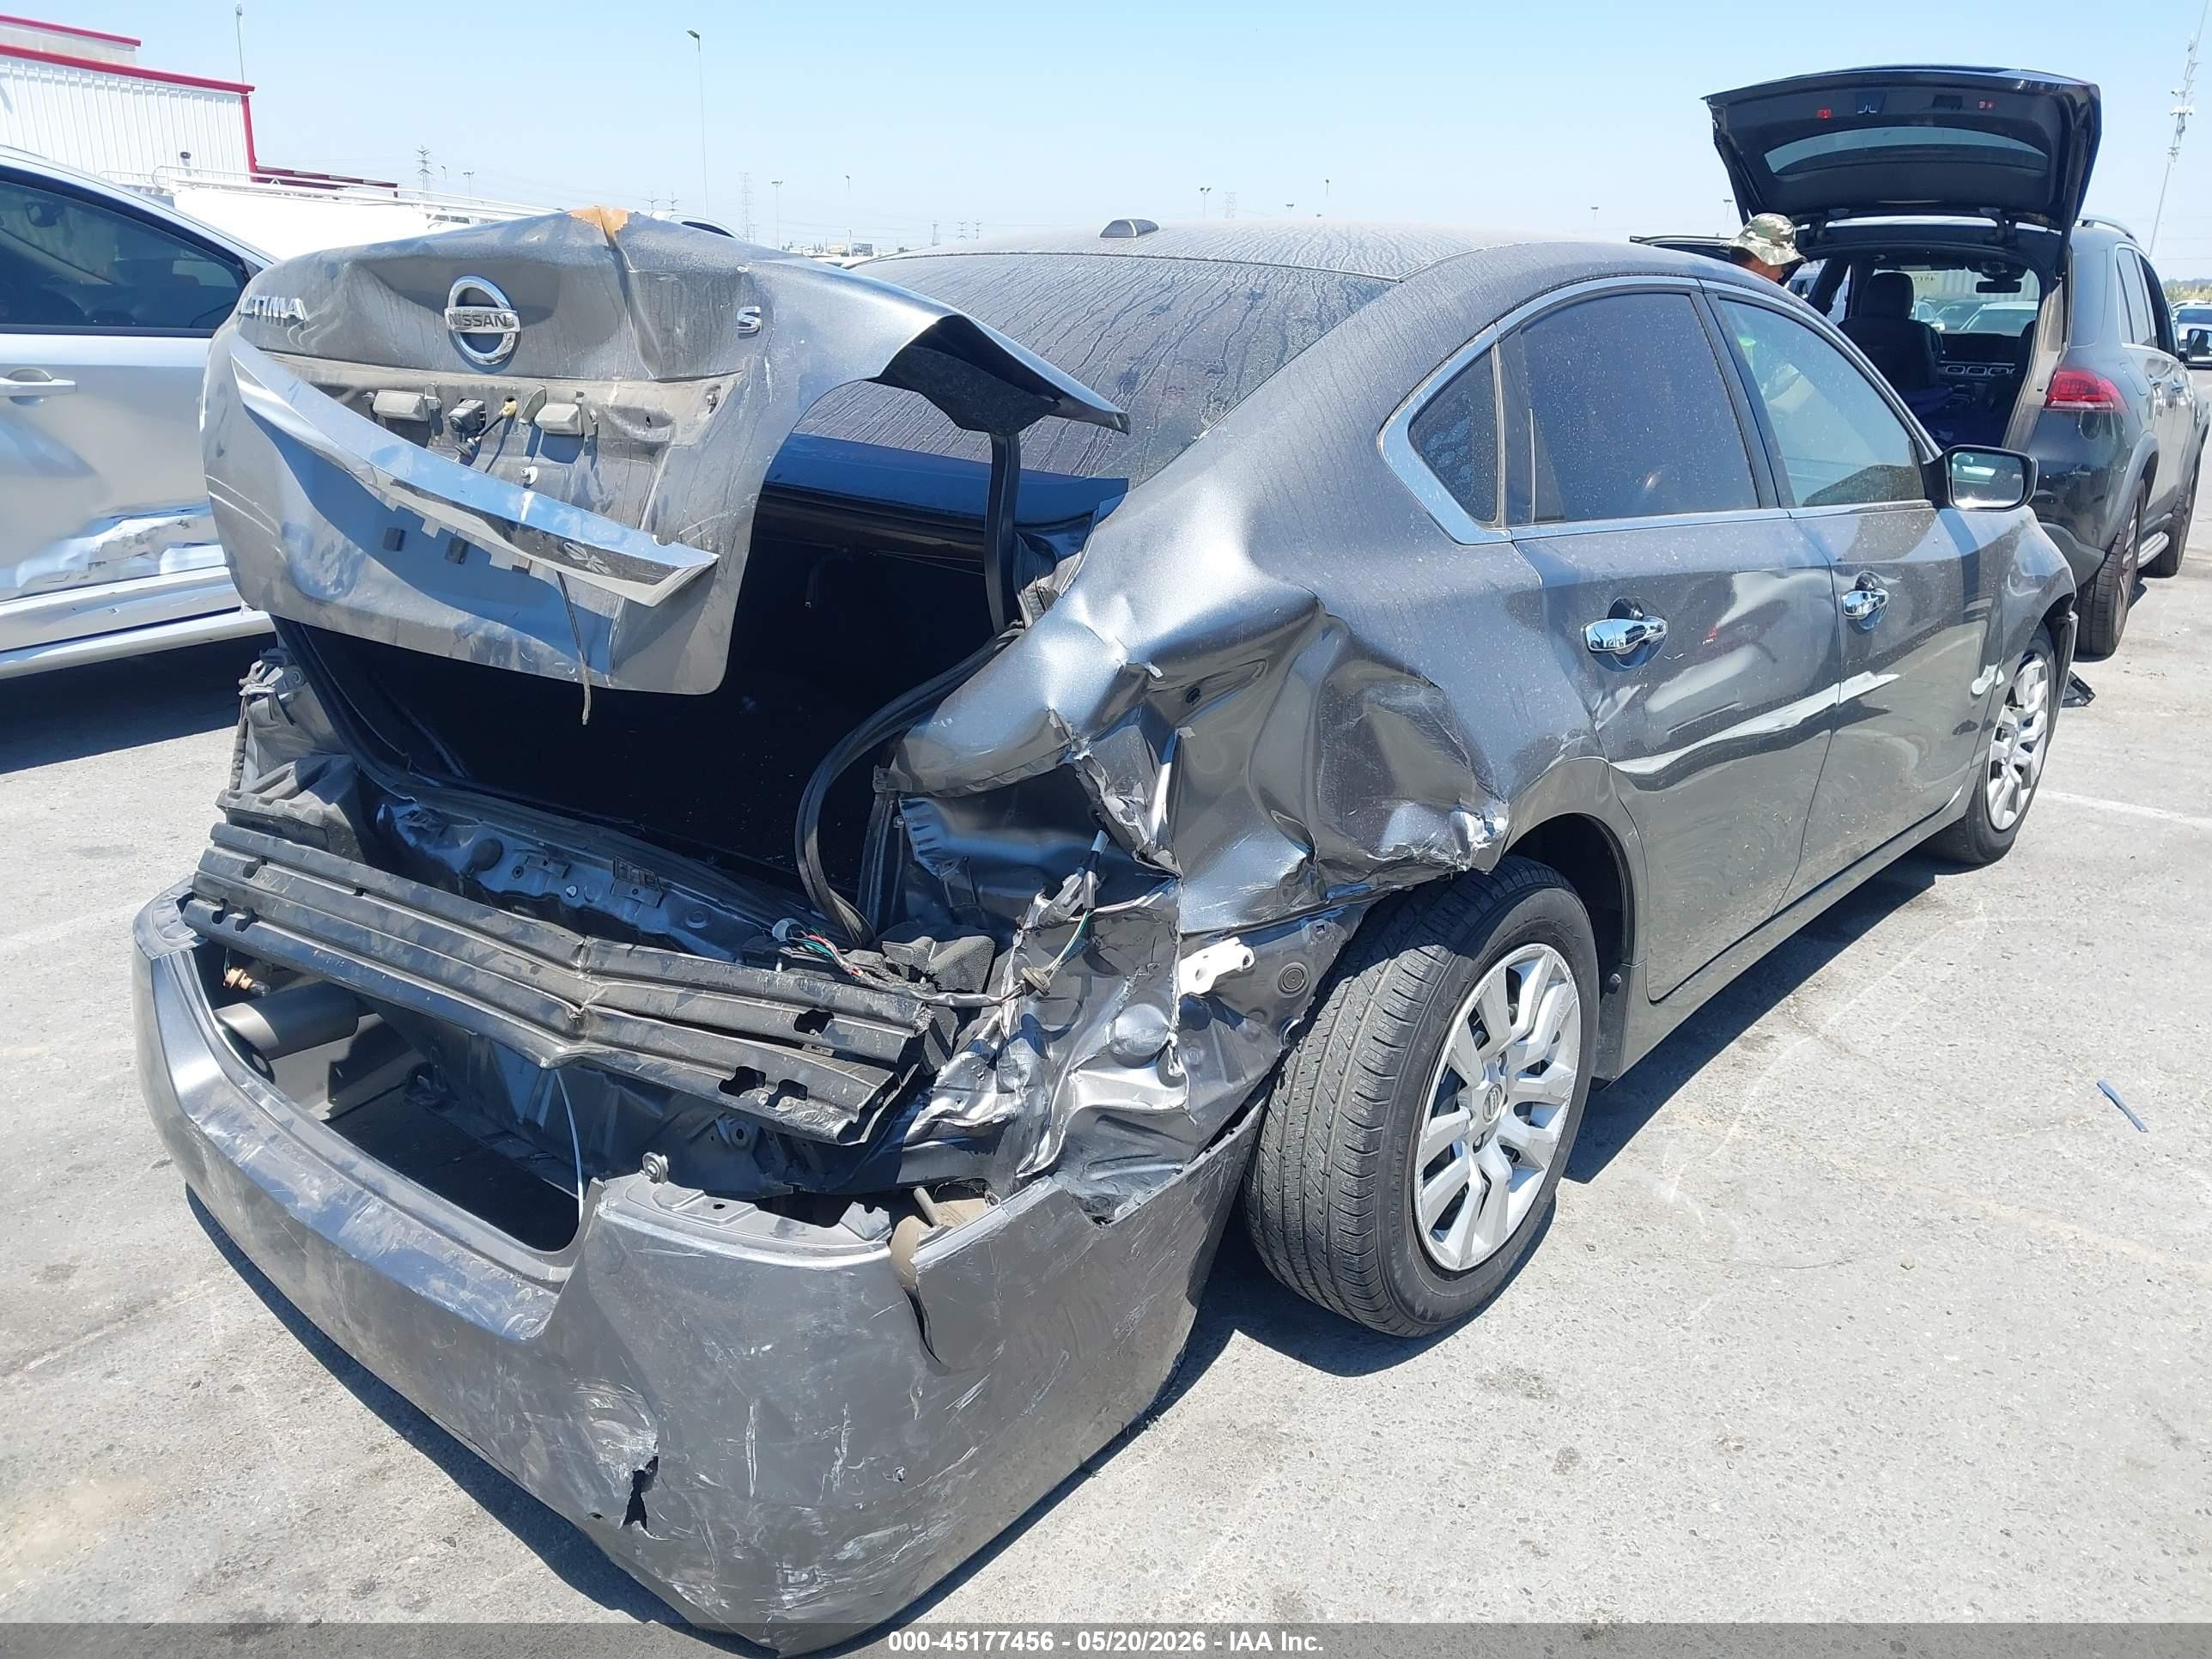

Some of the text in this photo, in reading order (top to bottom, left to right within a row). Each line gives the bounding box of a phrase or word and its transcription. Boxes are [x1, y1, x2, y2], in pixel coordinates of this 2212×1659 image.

[240, 295, 309, 322] LTIMA
[449, 313, 507, 327] NISSAN
[737, 305, 762, 334] S
